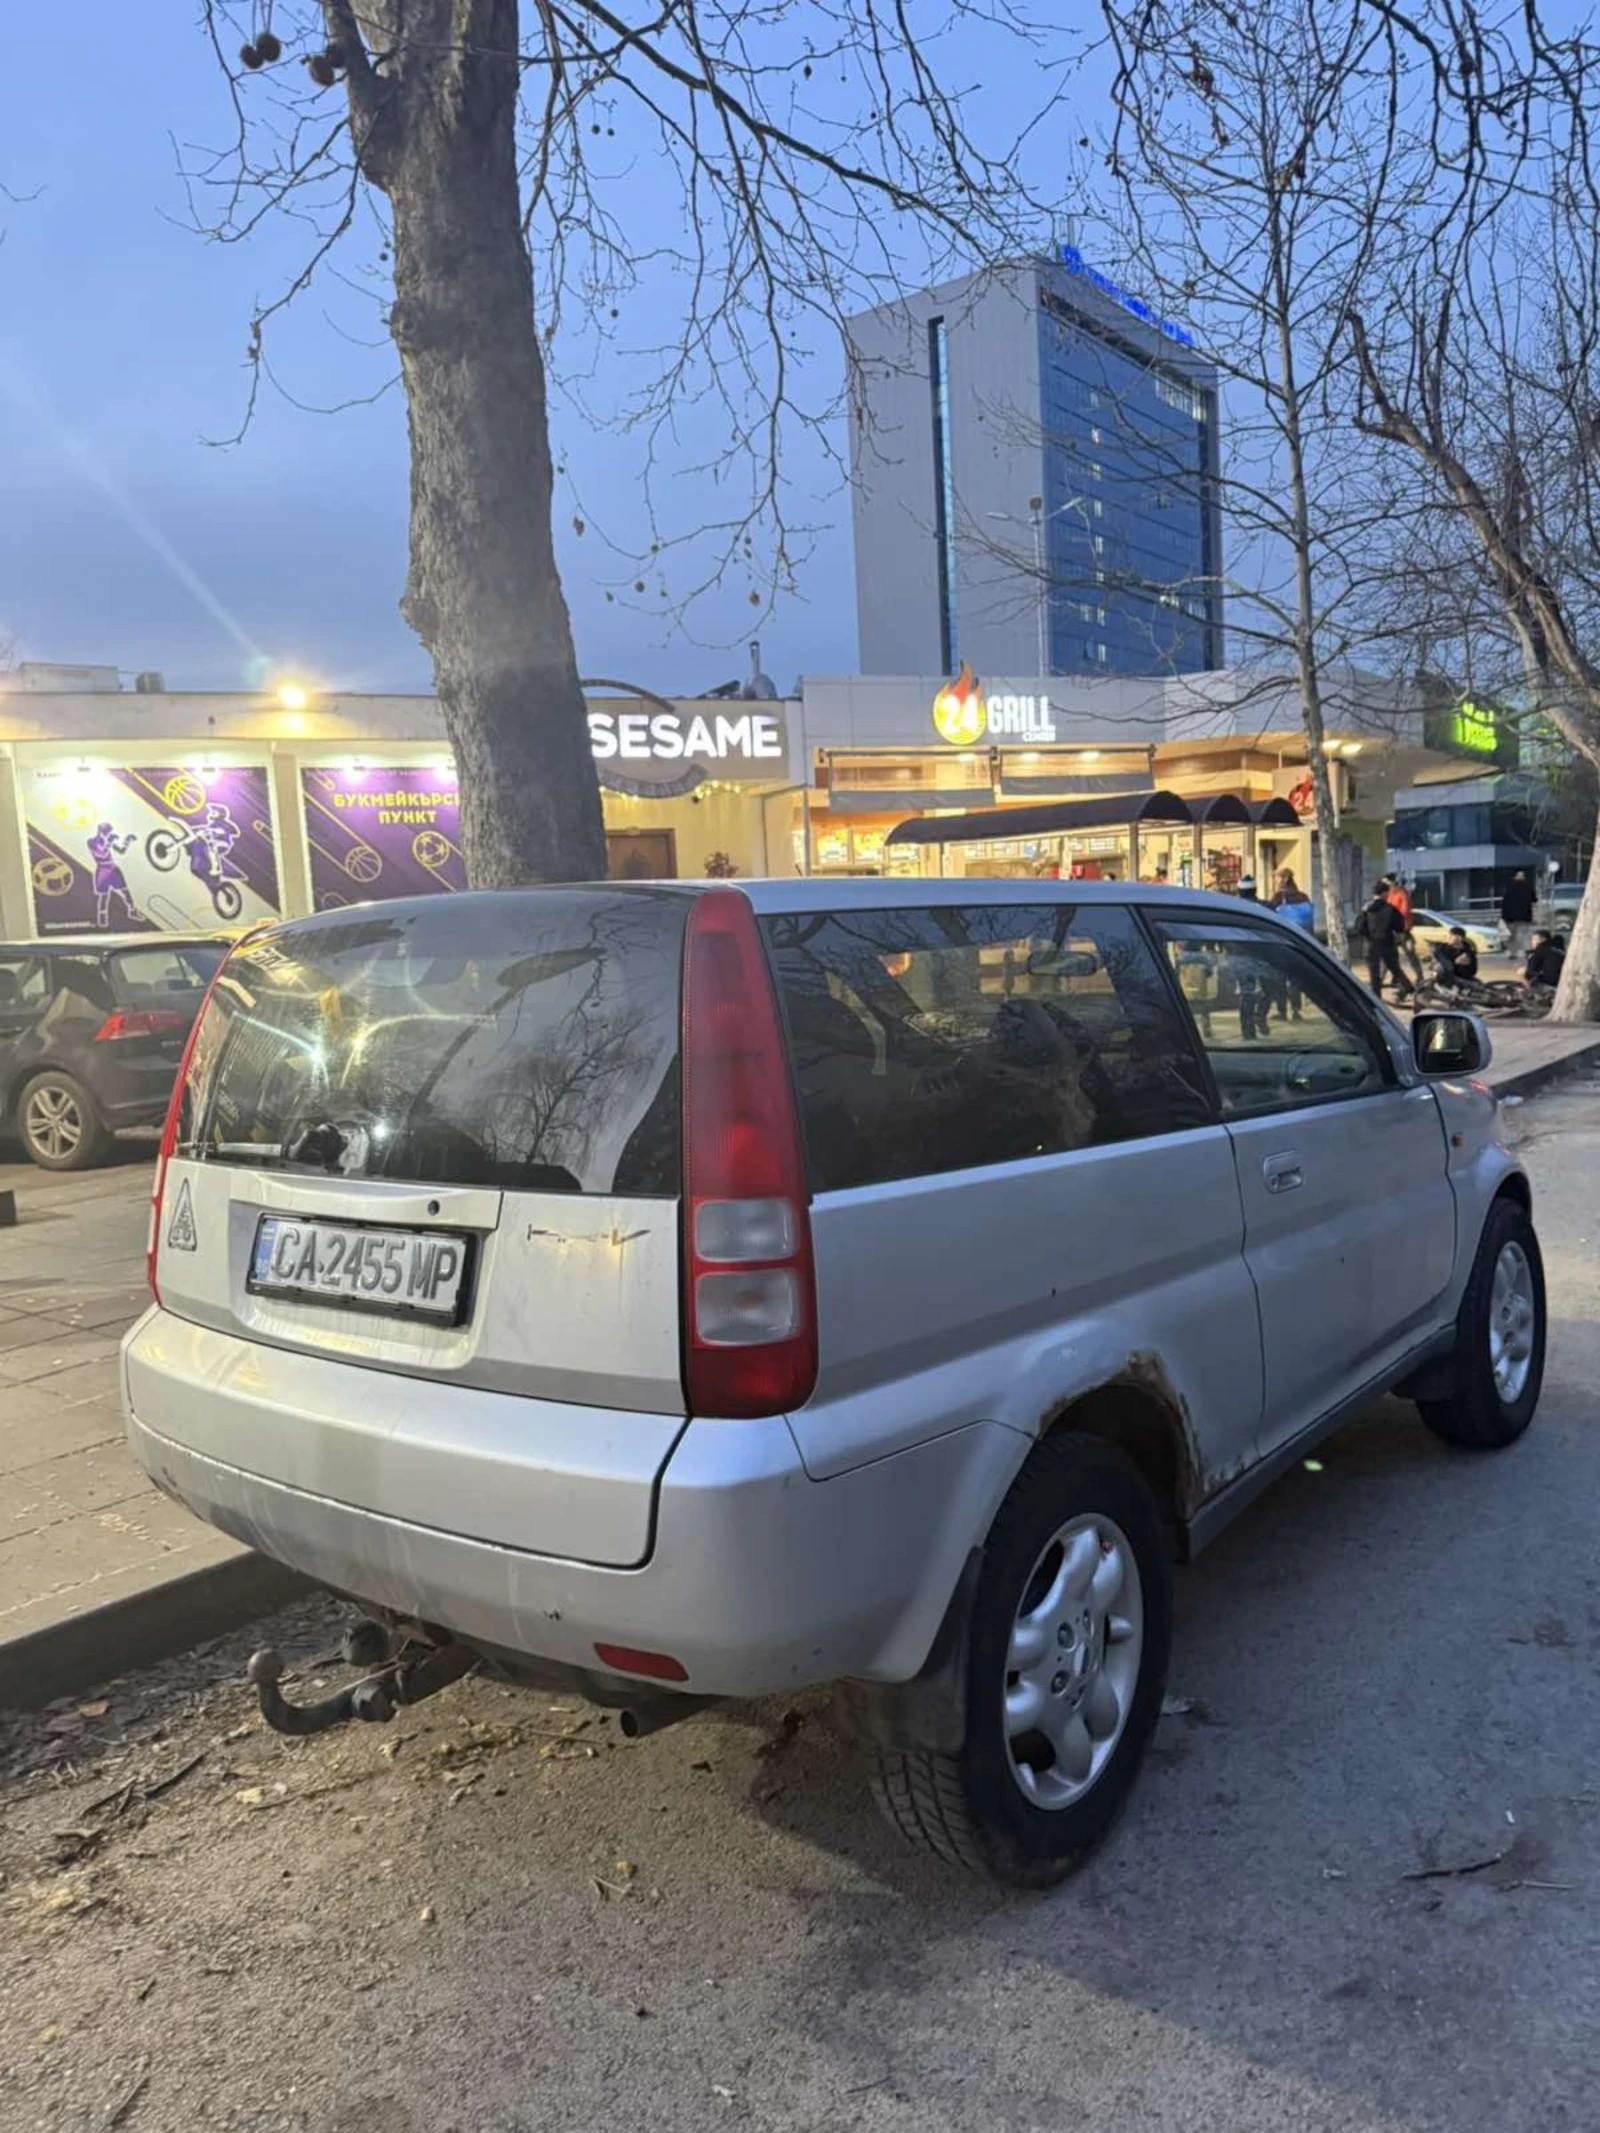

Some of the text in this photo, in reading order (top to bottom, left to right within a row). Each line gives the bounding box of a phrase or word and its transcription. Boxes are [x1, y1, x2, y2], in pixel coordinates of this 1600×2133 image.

[941, 692, 1057, 734] 24 GRILL
[587, 712, 783, 759] SESAME
[378, 810, 438, 824] ПУНКТ
